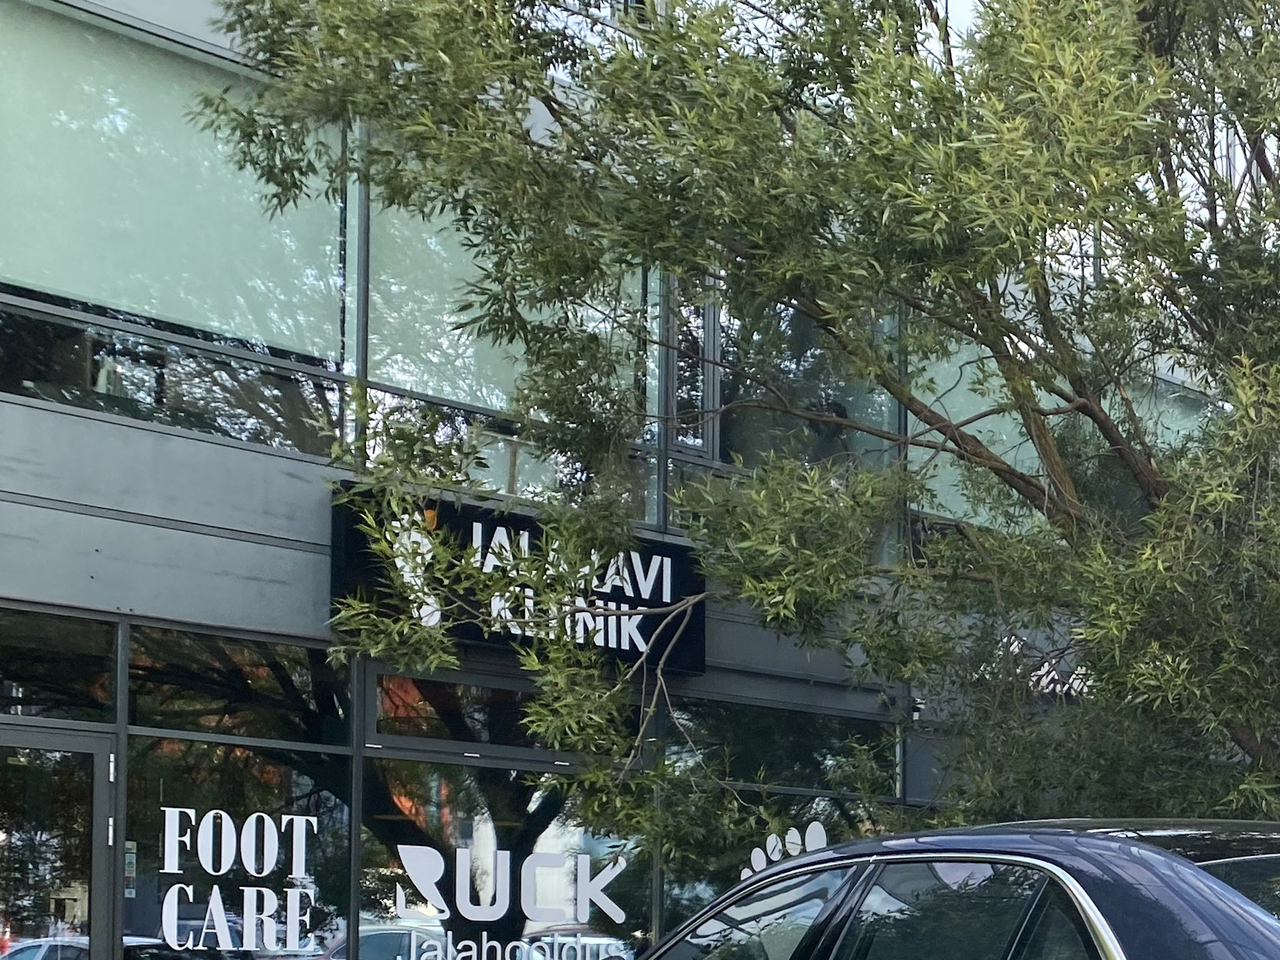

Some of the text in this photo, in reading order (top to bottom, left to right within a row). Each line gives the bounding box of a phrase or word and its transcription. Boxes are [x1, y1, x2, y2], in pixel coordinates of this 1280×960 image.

[159, 806, 318, 878] FOOT
[161, 883, 315, 951] CARE
[396, 844, 627, 924] RUCK
